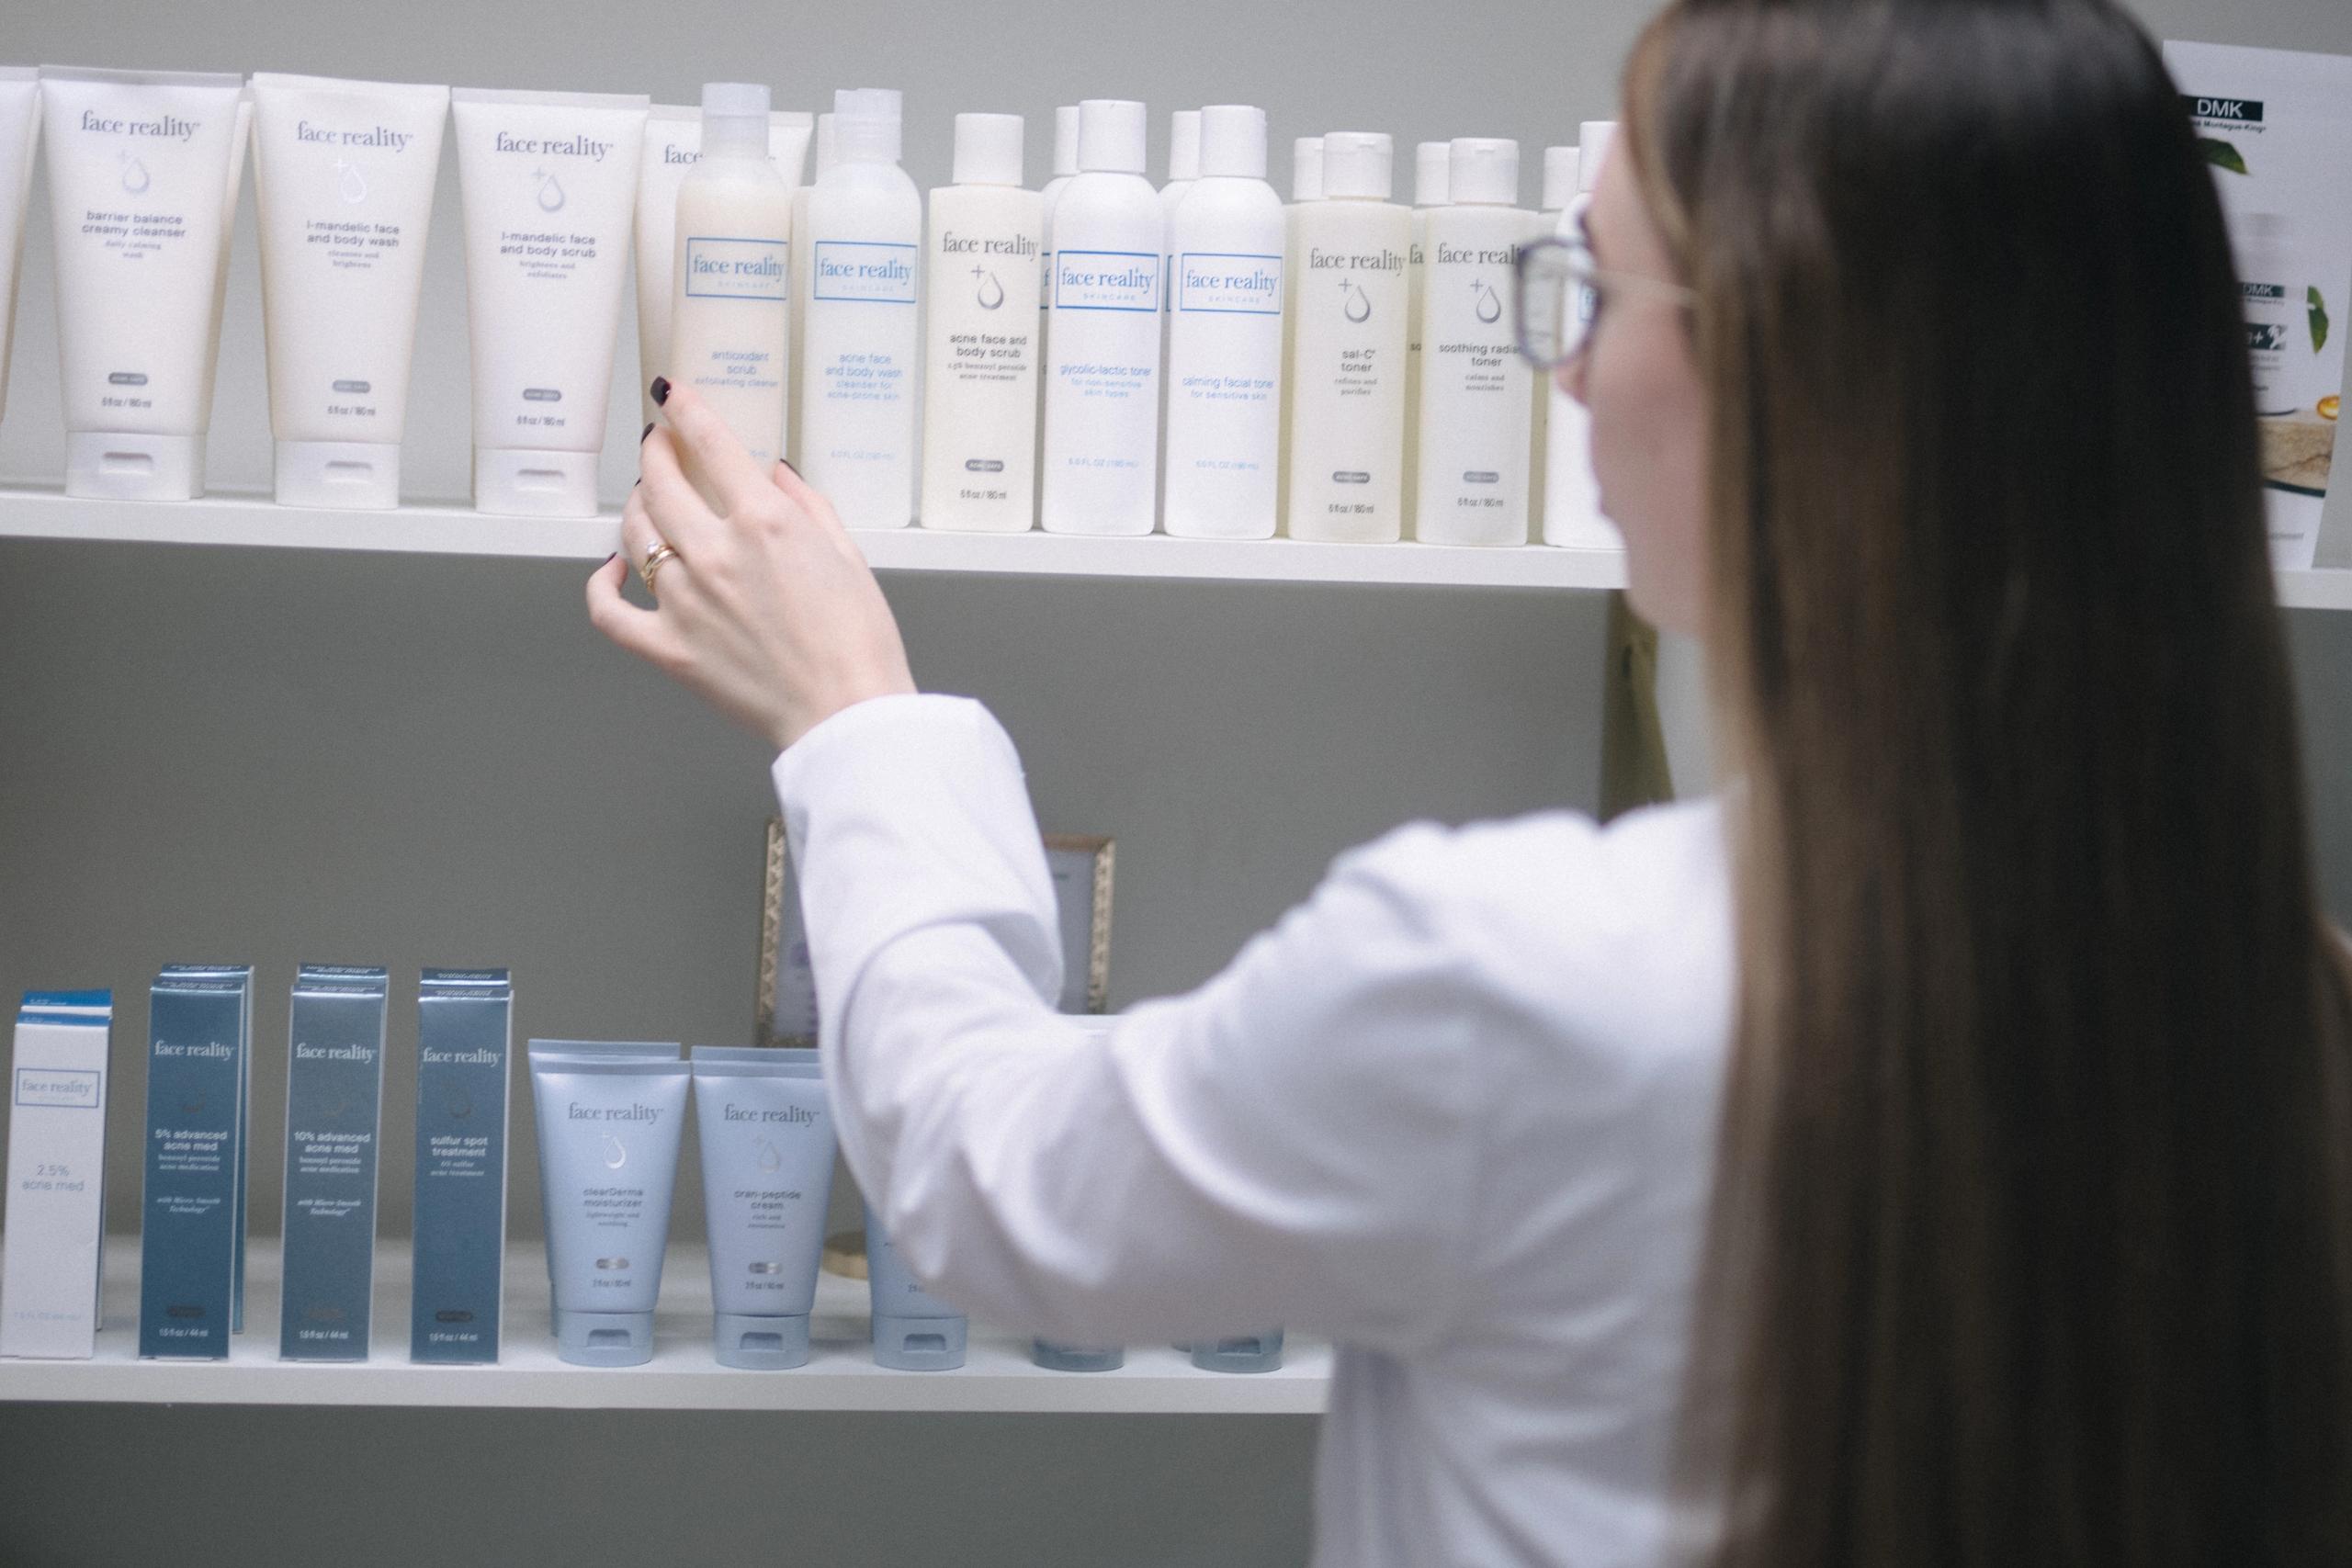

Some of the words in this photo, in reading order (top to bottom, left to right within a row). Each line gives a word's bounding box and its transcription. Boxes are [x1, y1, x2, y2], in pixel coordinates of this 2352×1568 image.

[2198, 98, 2244, 118] DMK
[82, 110, 123, 133] face
[129, 115, 197, 142] reality
[298, 120, 337, 141] face
[343, 127, 407, 152] reality
[496, 131, 537, 152] face
[542, 135, 608, 162] reality
[86, 210, 129, 221] barrier
[133, 213, 183, 224] balance
[82, 224, 129, 237] creamy
[132, 227, 186, 237] cleanser
[375, 223, 400, 234] face
[307, 233, 331, 243] and
[334, 235, 364, 246] body
[368, 237, 399, 246] wash
[570, 234, 595, 245] face
[500, 245, 523, 254] and
[527, 245, 557, 257] body
[561, 247, 596, 258] scrub
[943, 231, 978, 253] face
[984, 233, 1038, 263] reality
[1438, 243, 1472, 264] face
[693, 254, 729, 274] face
[1310, 248, 1345, 269] face
[1351, 250, 1404, 276] reality
[820, 258, 854, 277] face
[859, 259, 911, 286] reality
[1062, 267, 1093, 287] face
[1099, 268, 1153, 294] reality
[1187, 270, 1219, 288] face
[1225, 271, 1279, 298] reality
[950, 333, 978, 344] acne
[981, 333, 1006, 344] face
[1009, 335, 1027, 345] and
[956, 346, 987, 358] body
[990, 347, 1021, 358] scrub
[1439, 343, 1487, 356] soothing
[839, 355, 866, 364] acne
[869, 354, 891, 364] face
[1472, 356, 1503, 367] toner
[825, 367, 844, 377] and
[847, 367, 873, 378] body
[1341, 362, 1372, 372] toner
[1224, 377, 1250, 388] facial
[154, 1040, 184, 1056] face
[187, 1042, 233, 1062] reality
[297, 1042, 325, 1058] face
[328, 1043, 373, 1064] reality
[423, 1047, 450, 1062] face
[454, 1047, 499, 1067] reality
[22, 1078, 49, 1091] face
[51, 1079, 90, 1097] reality
[569, 1102, 602, 1121] face
[606, 1103, 659, 1126] reality
[724, 1103, 759, 1122] face
[763, 1105, 816, 1128] reality
[154, 1128, 172, 1139] 5%
[173, 1130, 228, 1140] advanced
[316, 1132, 371, 1143] advanced
[164, 1142, 191, 1151] acne
[193, 1142, 219, 1152] med
[430, 1135, 461, 1145] sulfur
[464, 1137, 489, 1147] spot
[305, 1145, 333, 1153] acne
[334, 1145, 359, 1154] med
[432, 1147, 486, 1157] treatment
[22, 1180, 52, 1190] acne
[55, 1181, 85, 1192] med
[584, 1198, 642, 1207] moisturizer
[751, 1201, 785, 1211] cream
